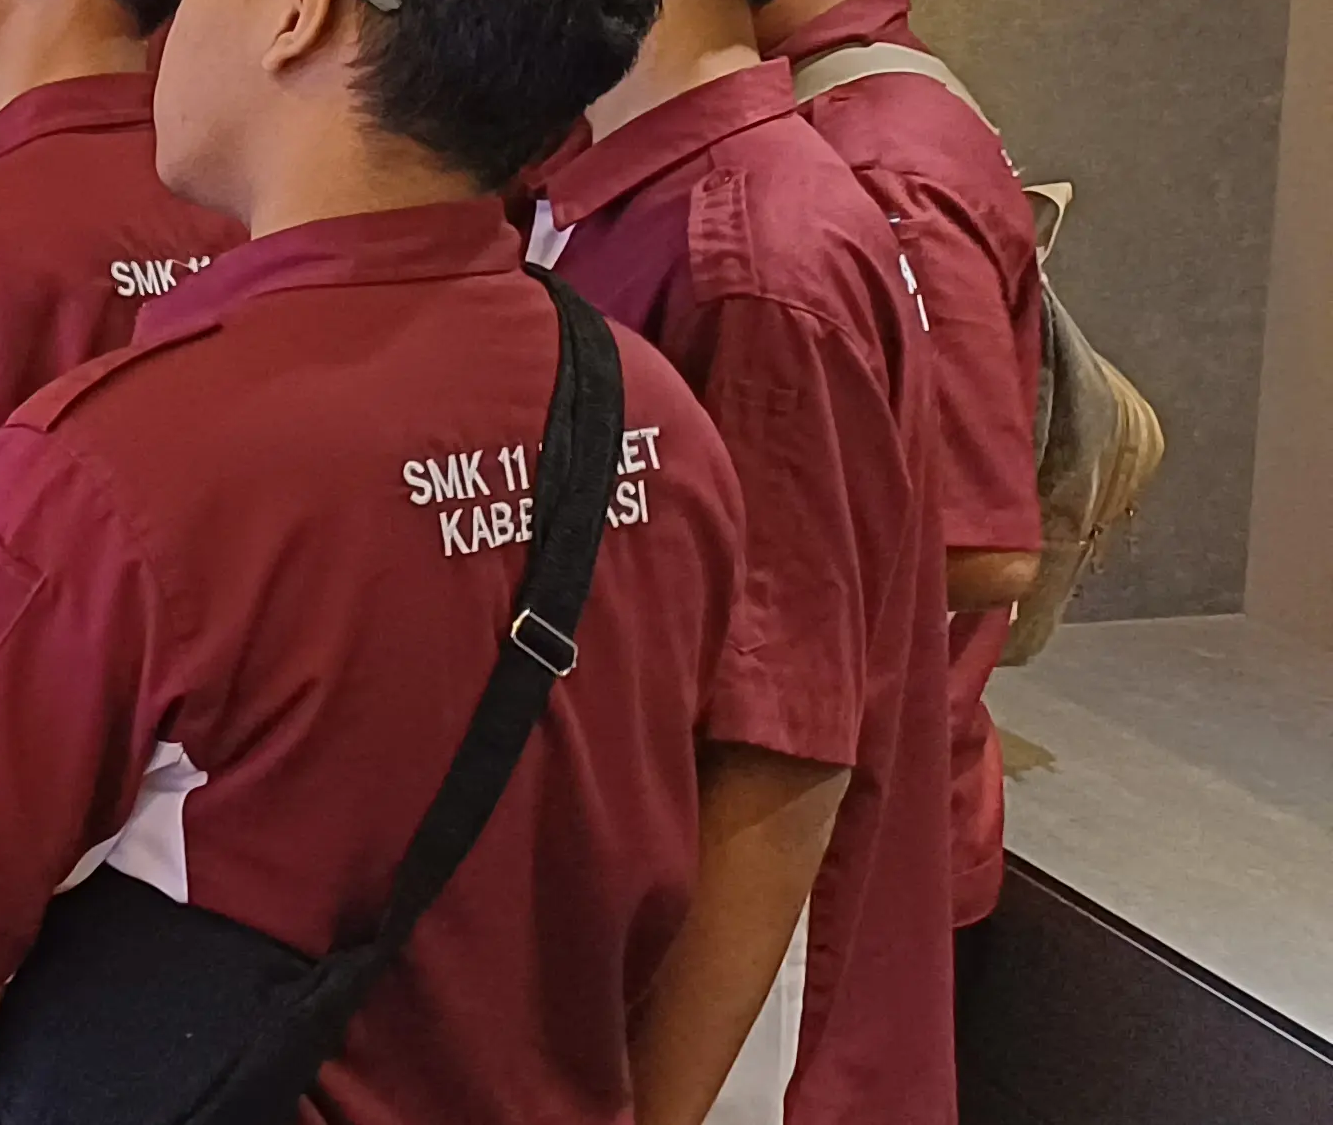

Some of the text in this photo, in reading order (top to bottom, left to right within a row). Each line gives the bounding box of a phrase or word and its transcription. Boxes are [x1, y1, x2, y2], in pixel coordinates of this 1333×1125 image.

[110, 258, 177, 296] SMK
[403, 449, 490, 505] SMK
[498, 444, 530, 492] 11
